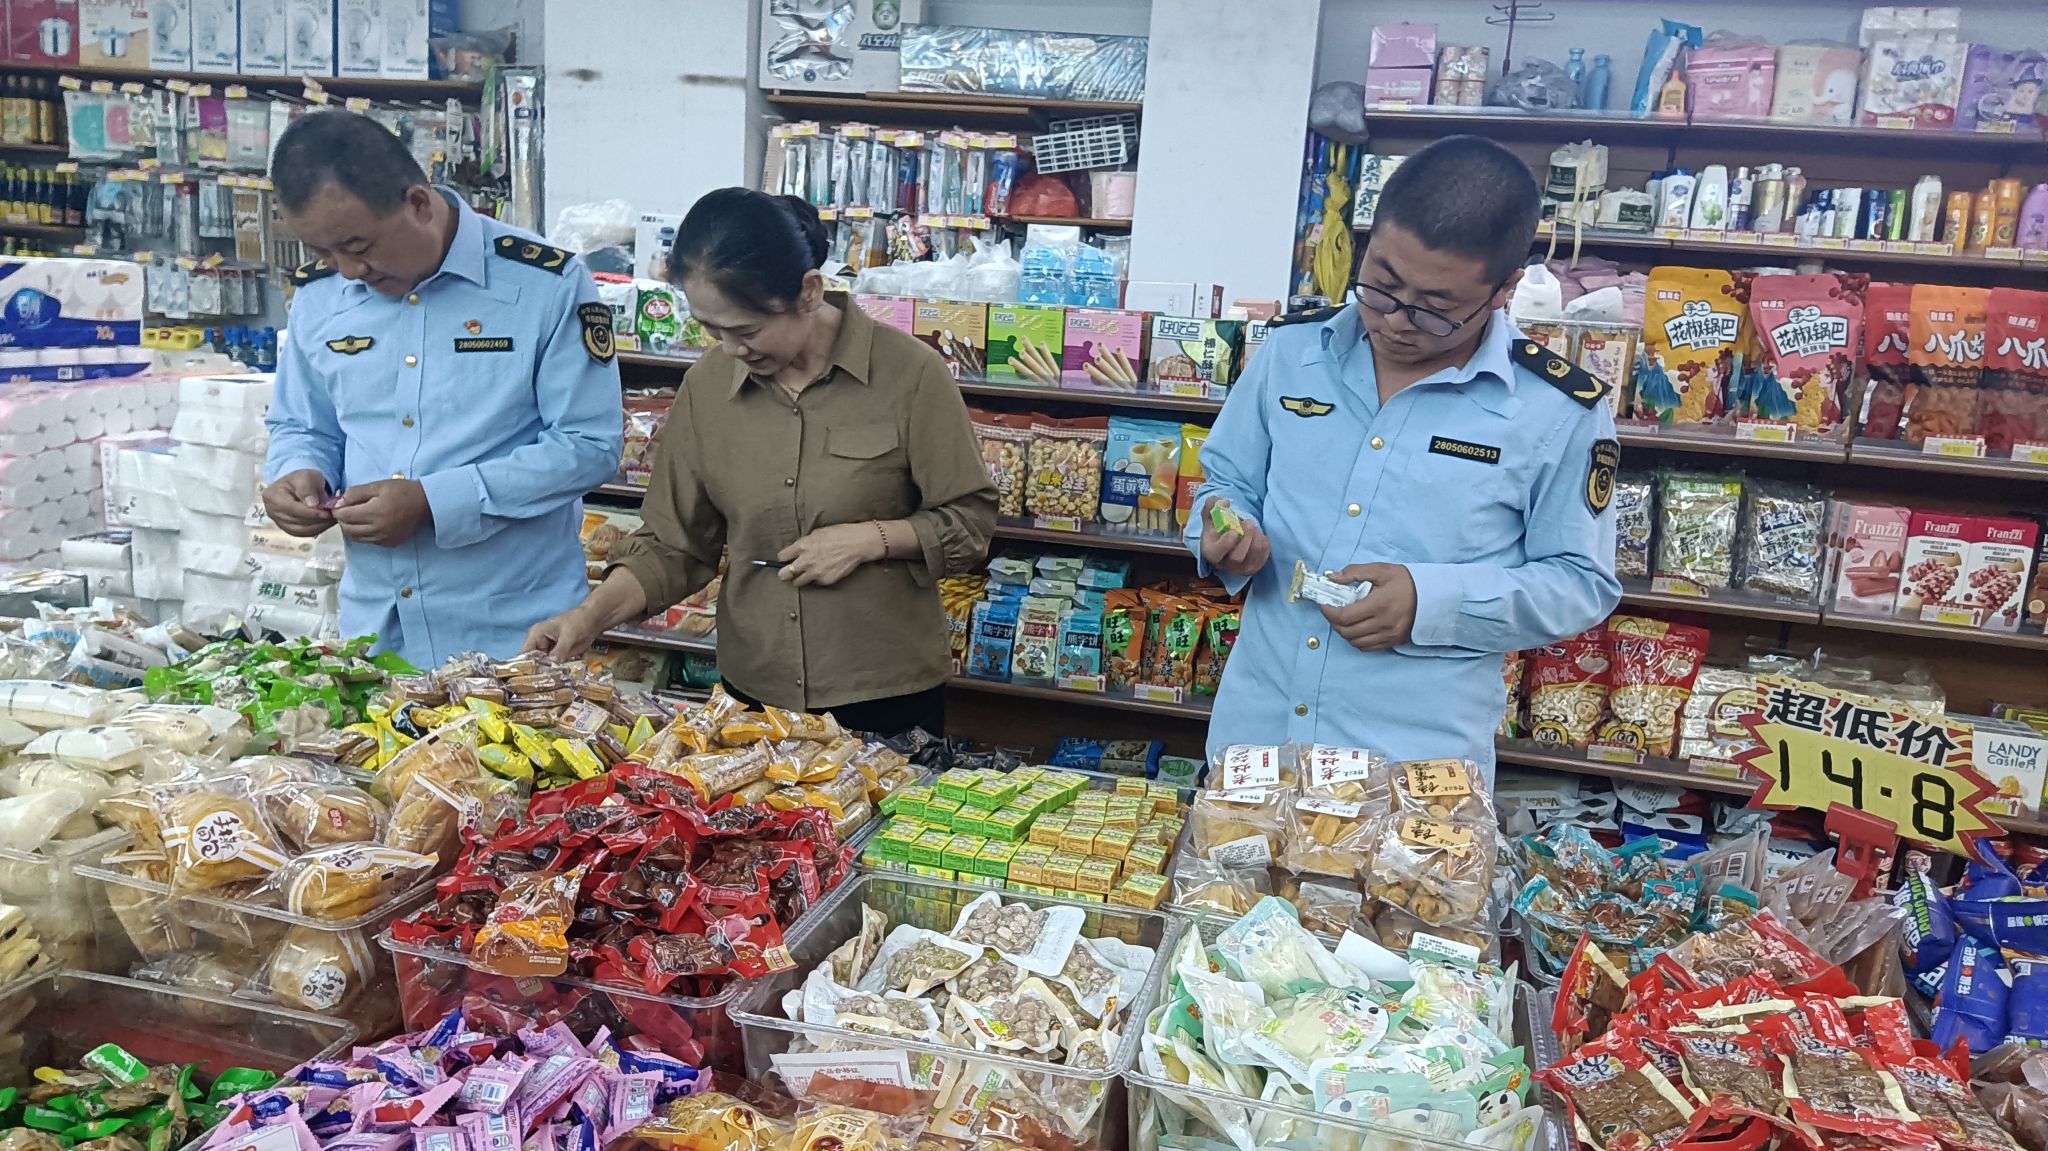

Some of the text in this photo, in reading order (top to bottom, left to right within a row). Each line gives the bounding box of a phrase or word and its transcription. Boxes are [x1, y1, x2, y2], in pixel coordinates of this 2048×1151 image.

[1158, 319, 1200, 337] 好吃点
[1669, 318, 1735, 343] 花椒锅巴
[1776, 322, 1844, 350] 花椒锅巴
[1434, 440, 1497, 459] 28050602513
[1854, 519, 1904, 537] Franzzi
[1924, 520, 1960, 535] Franzzi
[1987, 526, 2023, 541] Franzzi
[1767, 688, 1958, 766] 超低价
[1988, 741, 2041, 758] LANDY
[1987, 754, 2026, 768] Castle
[1779, 739, 1954, 841] 14.8
